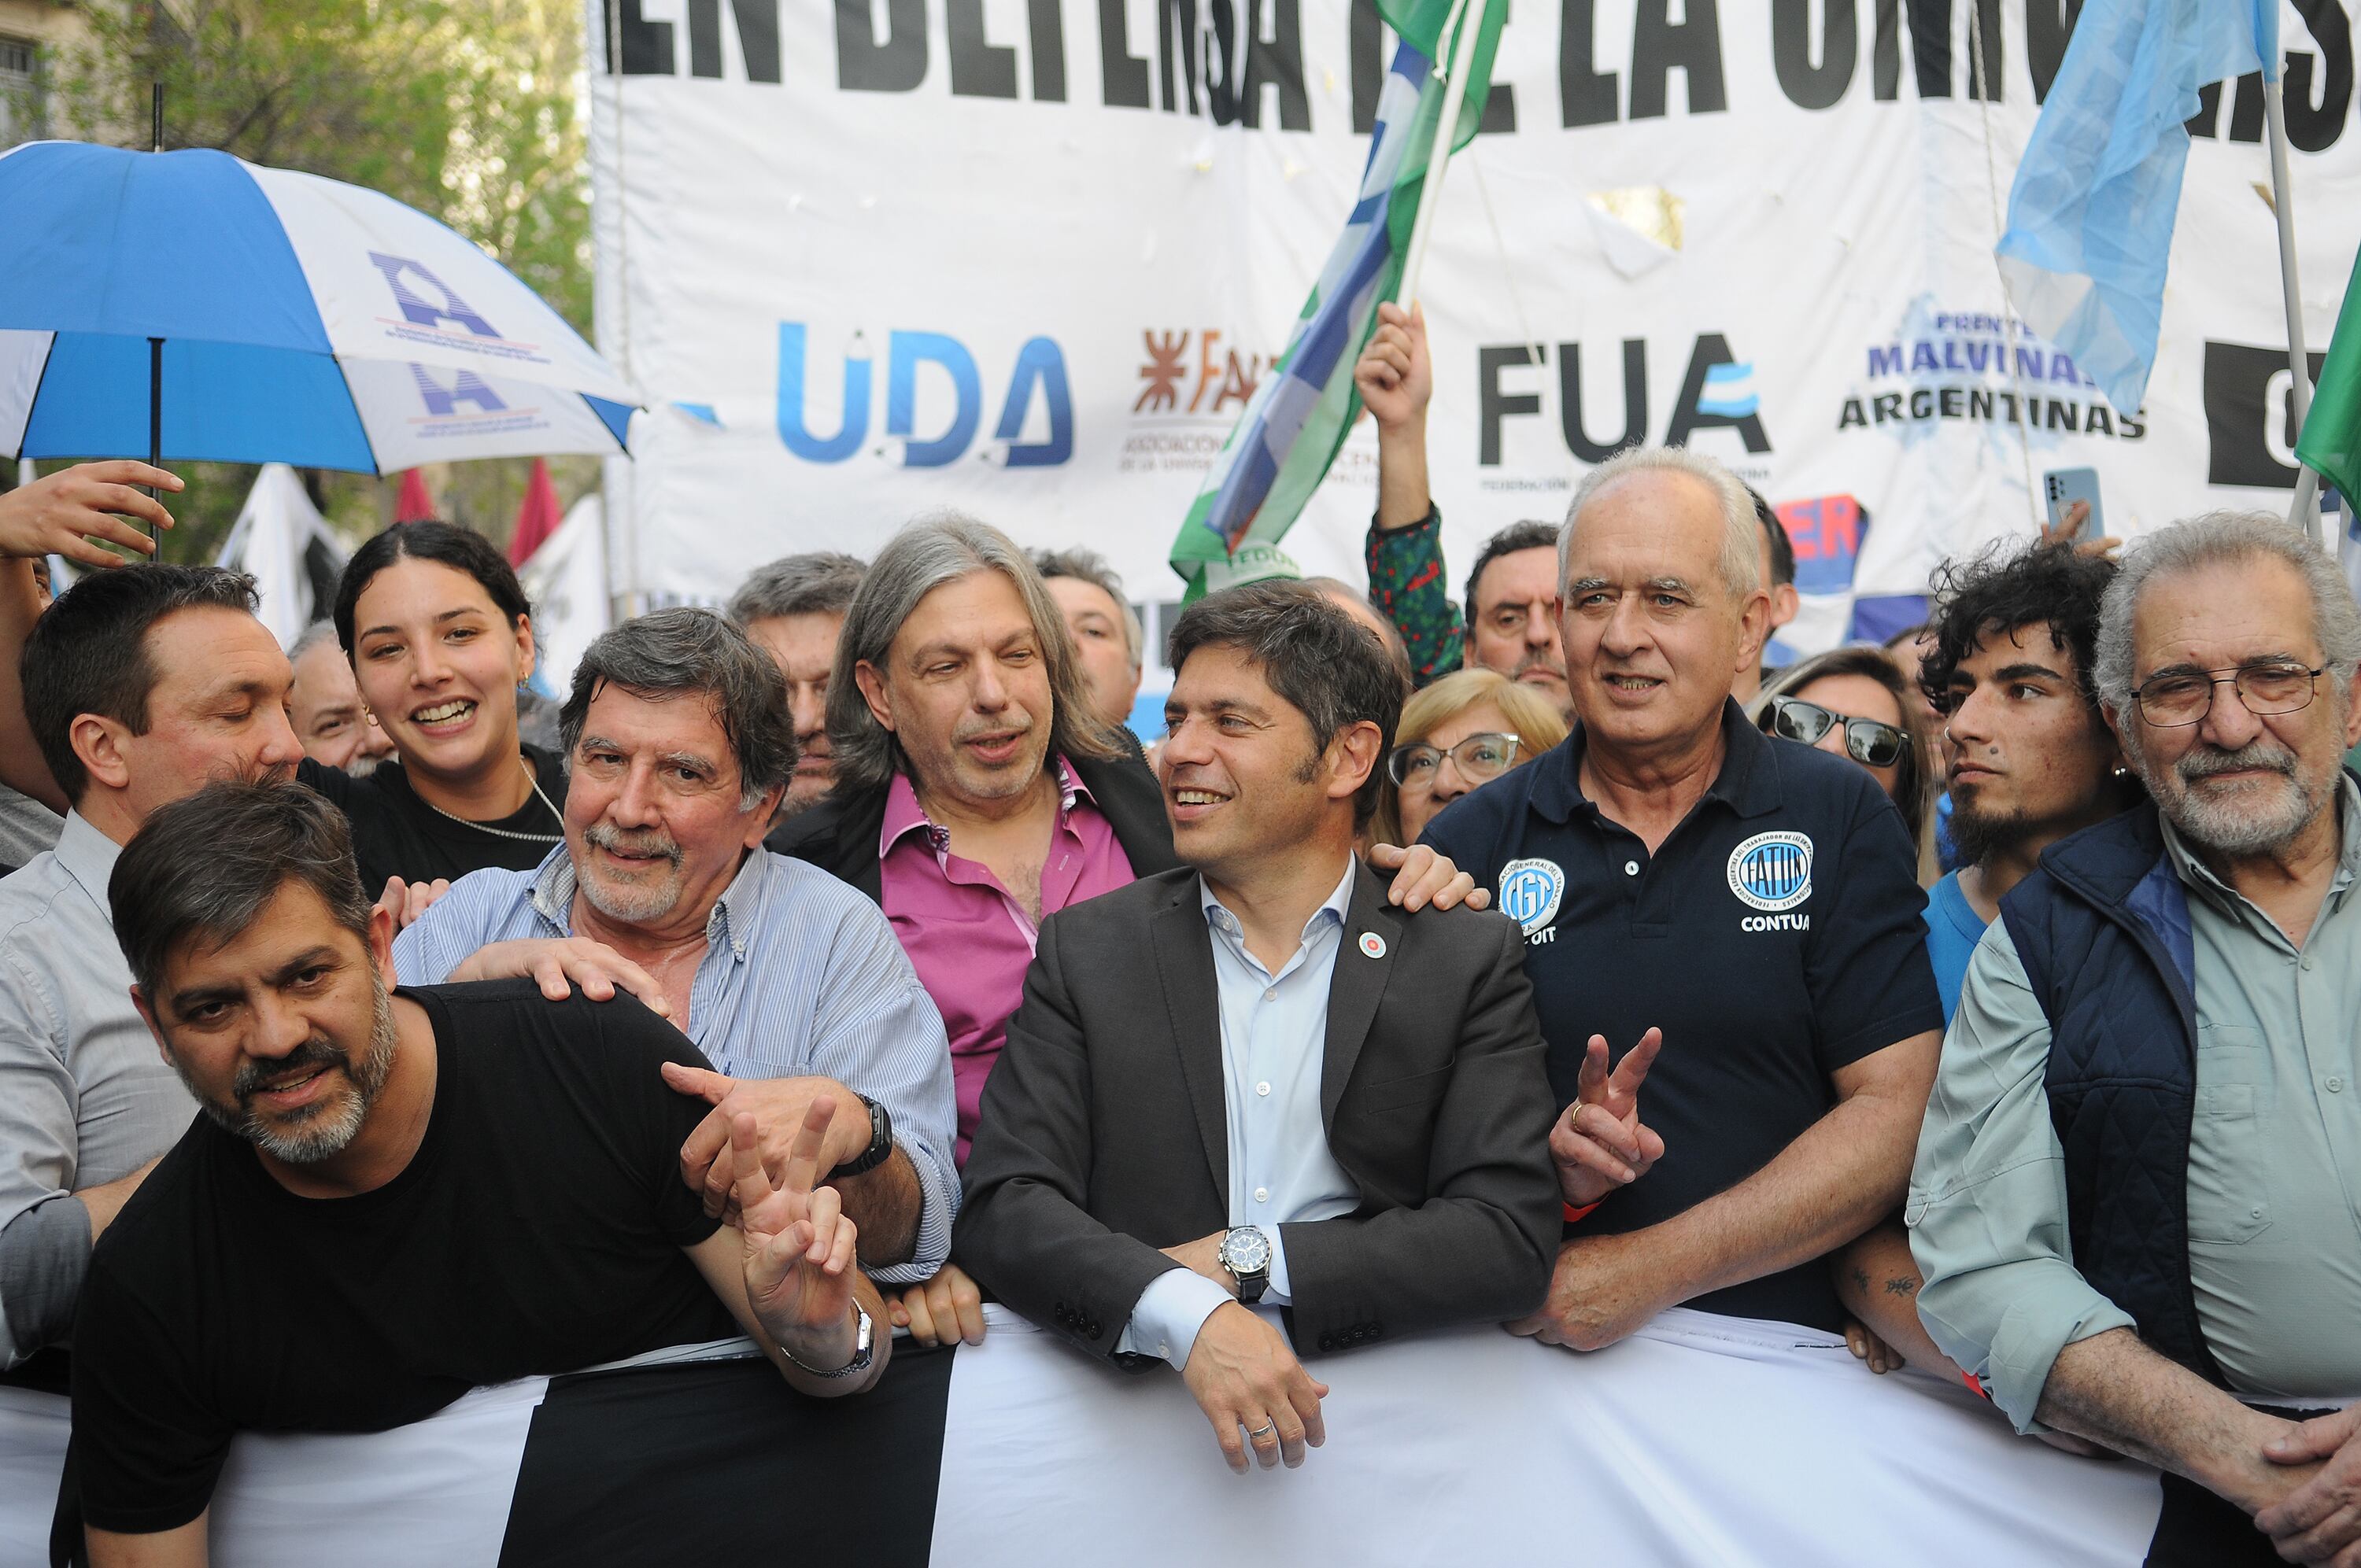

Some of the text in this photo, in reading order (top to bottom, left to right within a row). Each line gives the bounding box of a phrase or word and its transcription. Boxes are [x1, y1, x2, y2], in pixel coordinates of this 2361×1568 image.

[1868, 341, 2096, 386] MALVINA
[1479, 334, 1772, 466] FUA
[1838, 389, 2146, 439] ARGENTINAS
[1743, 834, 1783, 850] TRABAJADOR
[1747, 847, 1802, 896] FATUN
[1740, 913, 1811, 932] CONTUA
